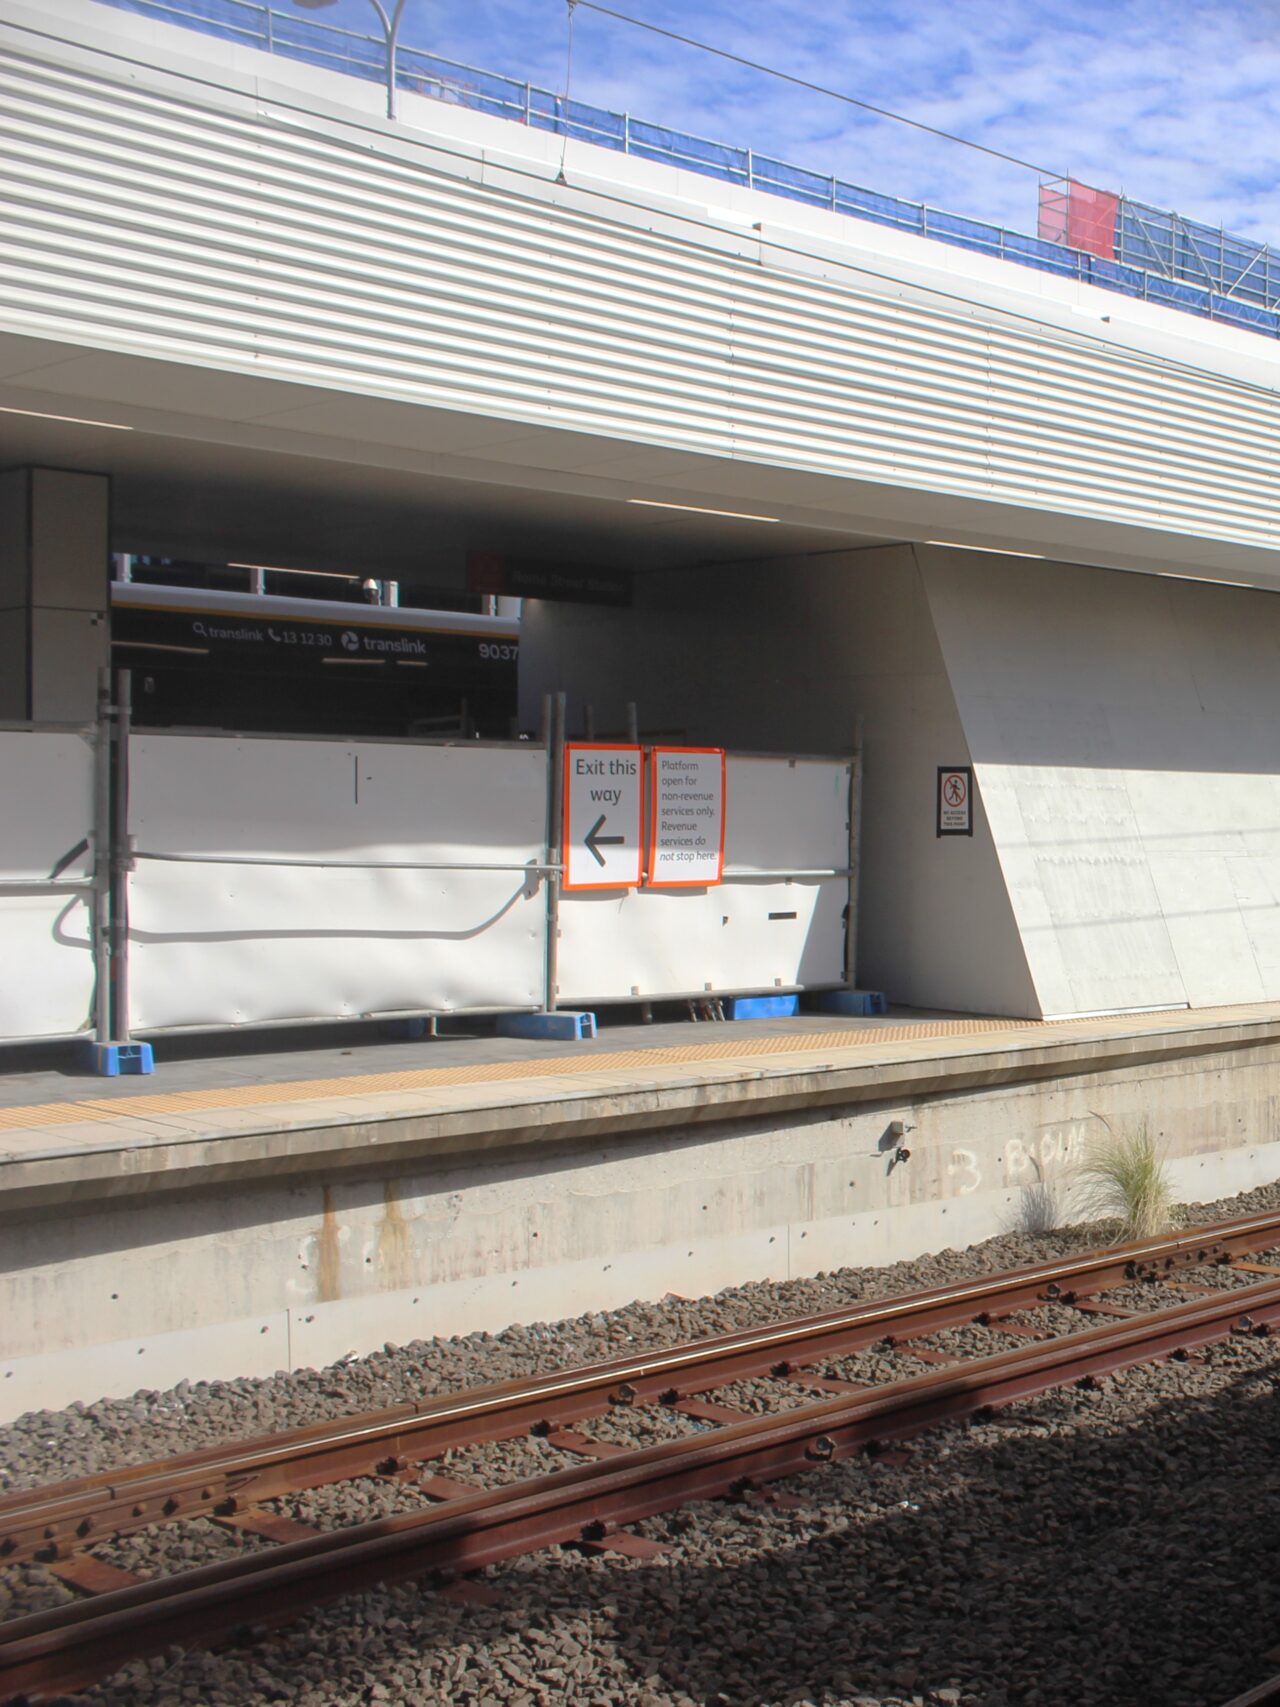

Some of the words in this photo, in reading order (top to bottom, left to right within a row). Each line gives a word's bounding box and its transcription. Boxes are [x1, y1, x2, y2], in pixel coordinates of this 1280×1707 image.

[208, 626, 264, 641] translink
[282, 631, 298, 644] 13
[363, 637, 427, 654] translink
[478, 643, 519, 661] 9037
[575, 758, 605, 776] Exit
[609, 759, 637, 776] this
[661, 760, 699, 771] Platform
[661, 777, 683, 788] open
[685, 775, 697, 786] for
[590, 789, 622, 806] way
[661, 791, 714, 801] non-revenue
[661, 806, 694, 816] services
[696, 805, 715, 818] only.
[661, 821, 697, 831] Revenue
[660, 837, 693, 846] services
[694, 837, 706, 846] do
[659, 852, 674, 861] not
[675, 852, 695, 863] stop
[696, 851, 717, 861] here.
